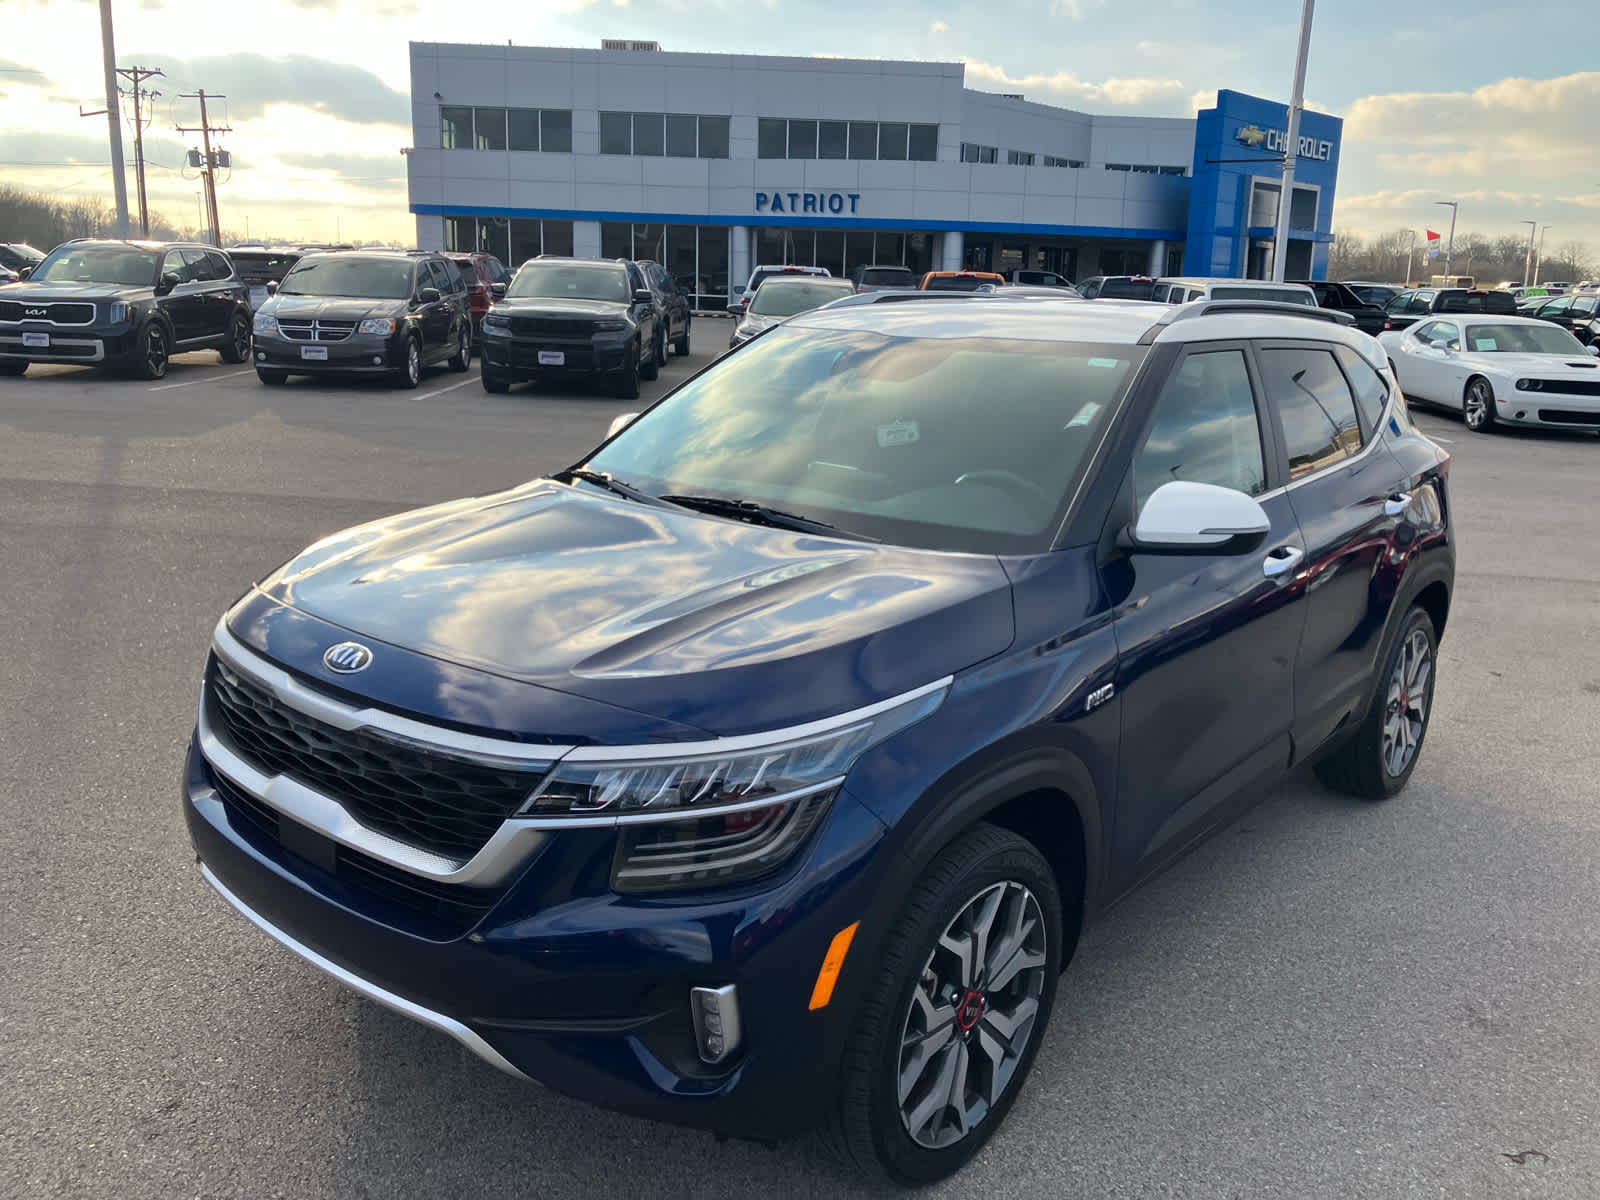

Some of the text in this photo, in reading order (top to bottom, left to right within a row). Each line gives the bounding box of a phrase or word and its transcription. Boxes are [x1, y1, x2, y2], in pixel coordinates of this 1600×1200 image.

[1266, 129, 1333, 161] CHEROLET
[755, 192, 861, 214] PATRIOT
[326, 646, 364, 669] KIA
[1086, 683, 1114, 711] AWD
